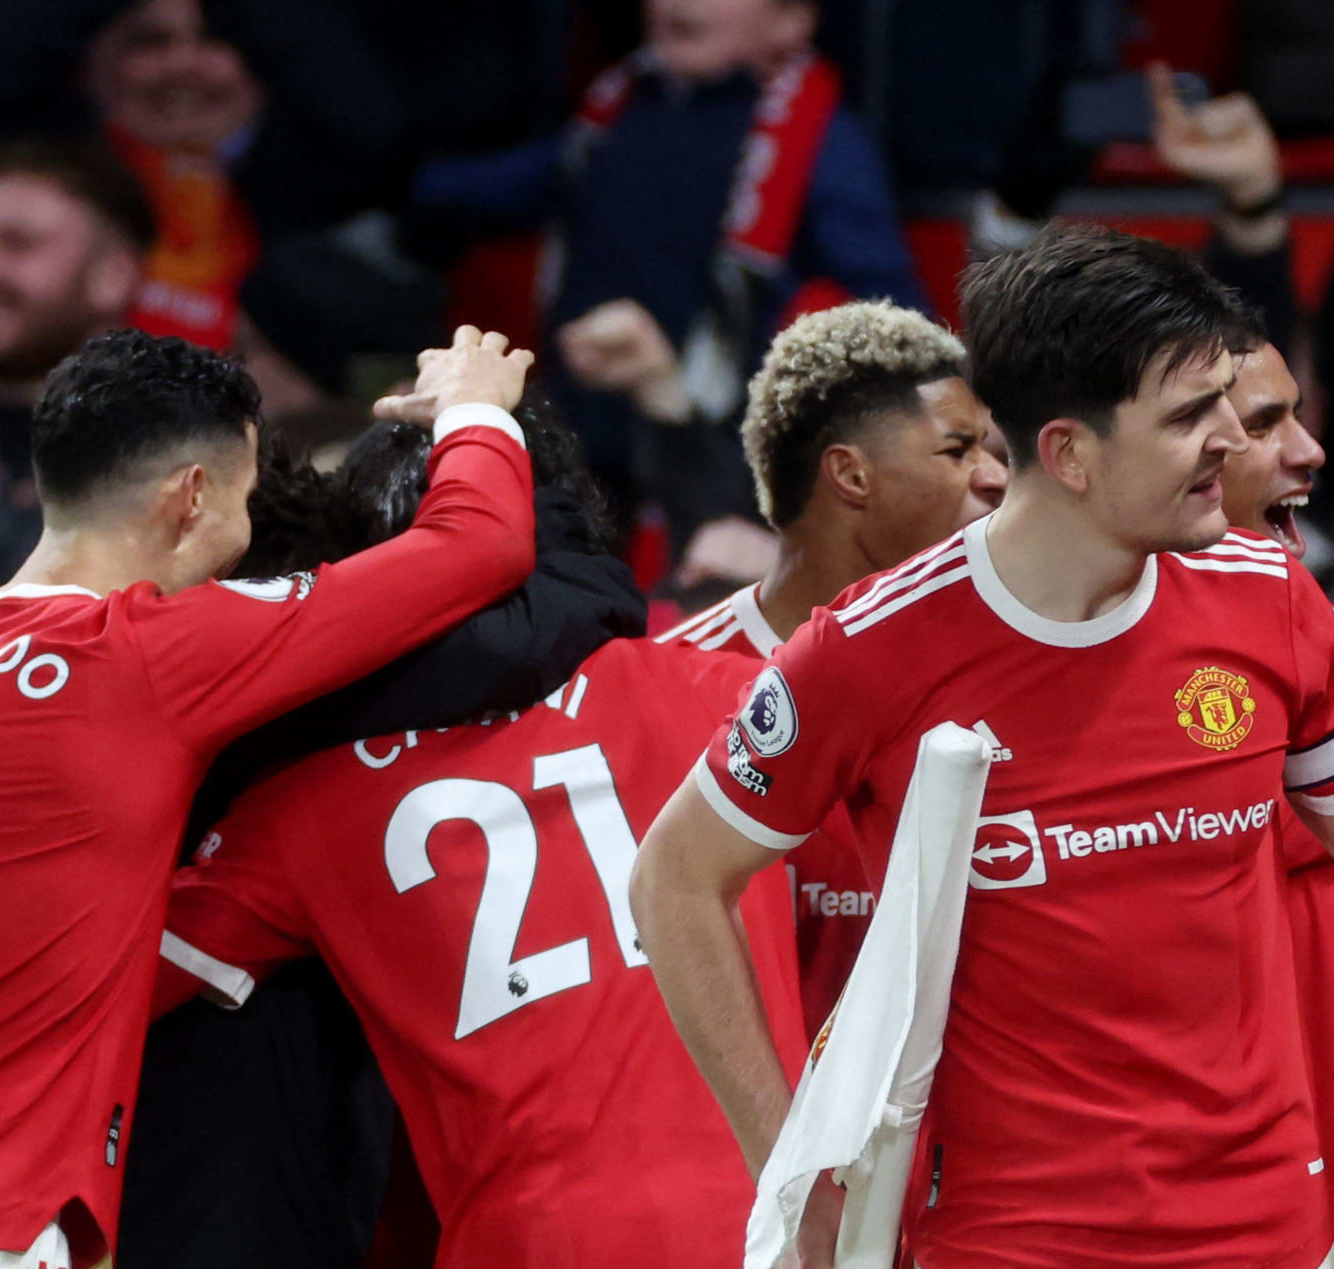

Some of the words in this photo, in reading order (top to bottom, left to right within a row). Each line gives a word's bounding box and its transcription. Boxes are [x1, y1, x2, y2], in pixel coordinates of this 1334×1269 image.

[1182, 673, 1244, 705] MANCHESTER
[1202, 725, 1246, 745] UNITED
[1043, 798, 1275, 861] TeamViewer
[384, 742, 652, 1041] 21
